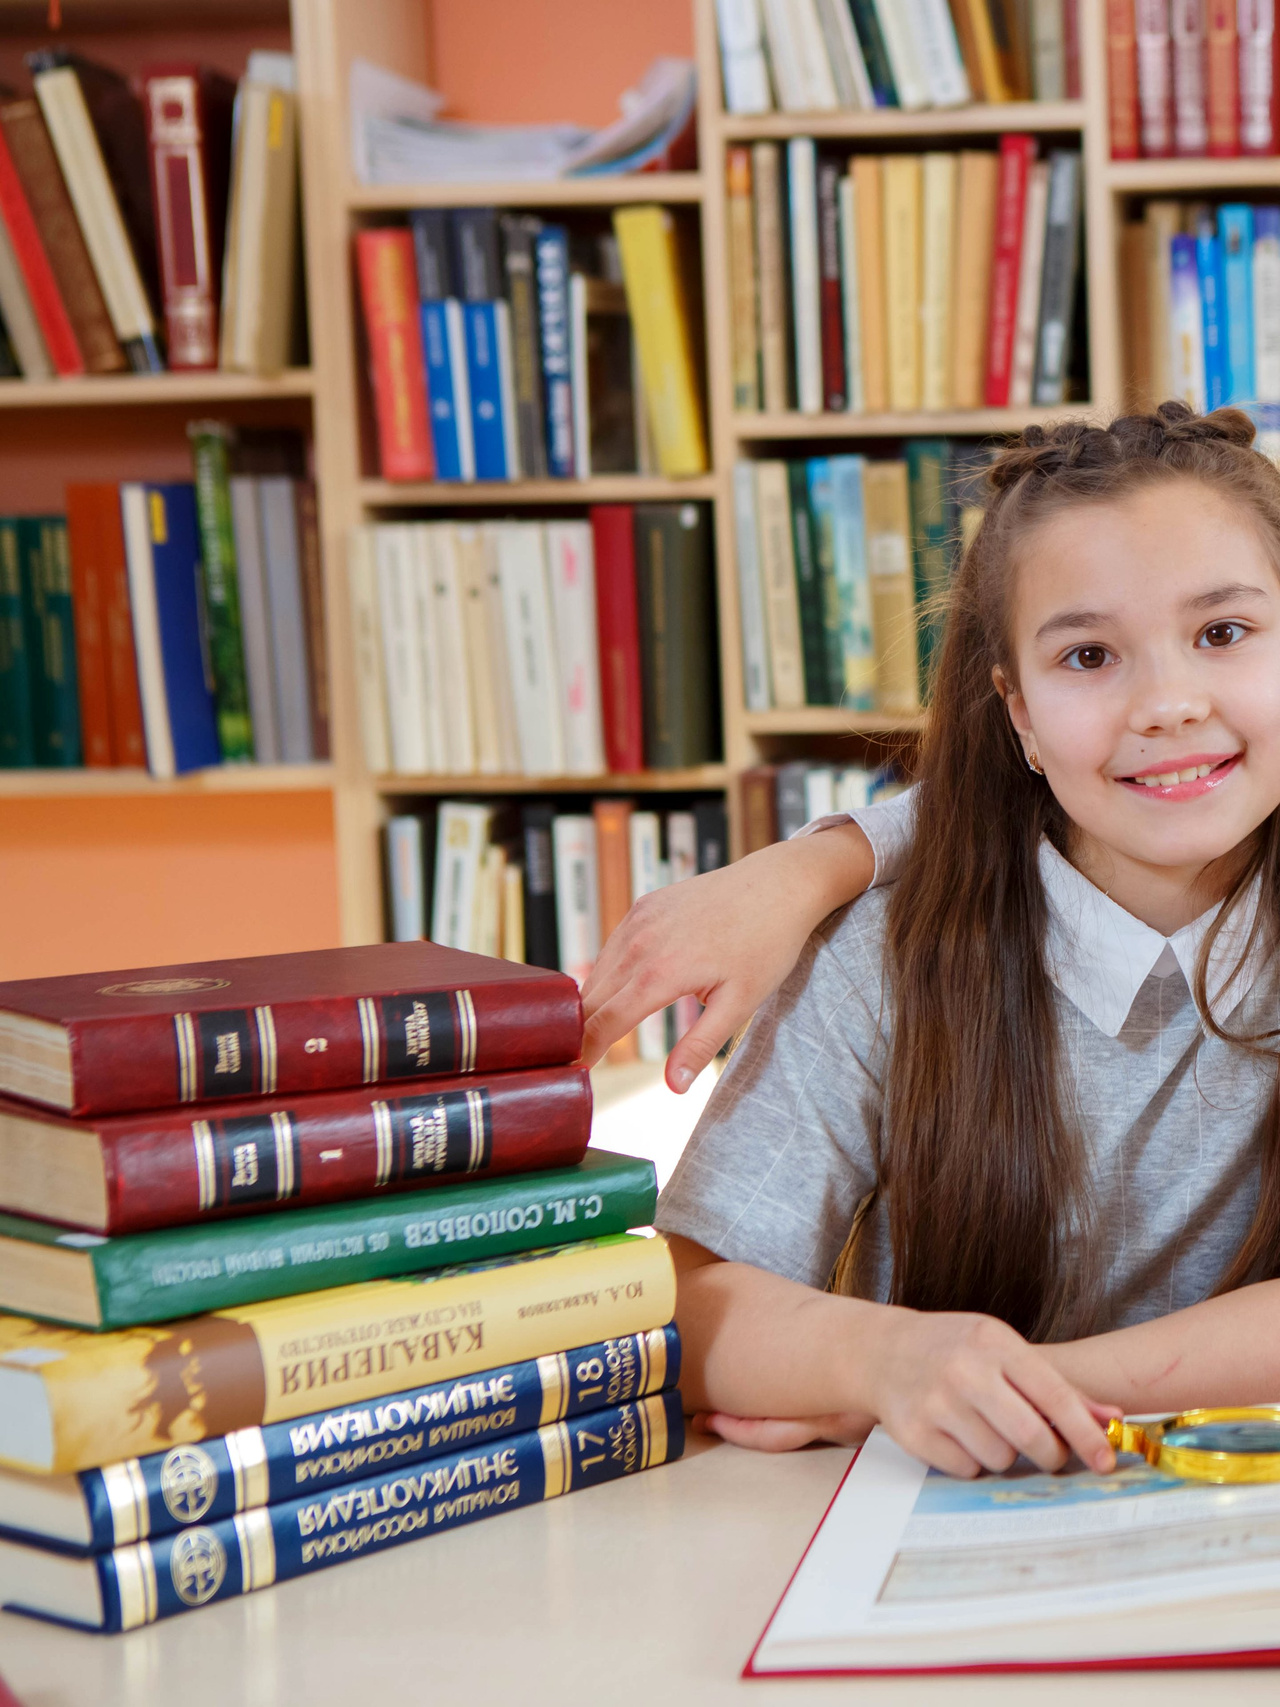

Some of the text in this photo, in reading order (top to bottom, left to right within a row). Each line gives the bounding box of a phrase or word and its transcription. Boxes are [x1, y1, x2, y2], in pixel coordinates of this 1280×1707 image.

[319, 1148, 344, 1164] 1
[289, 1234, 365, 1266] ИСТОРИИ
[276, 1320, 382, 1362] ОТЕЧЕСТВУ
[279, 1321, 485, 1397] КАВАЛЕРИЯ
[603, 1339, 622, 1405] ЛОМОН
[576, 1357, 604, 1403] 18
[288, 1374, 517, 1457] ЭНЦИКЛОПЕДИЯ
[295, 1406, 517, 1484] БОЛЬШАЯ РОССИЙСКАЯ
[618, 1404, 637, 1473] ЛОМОН
[576, 1429, 606, 1473] 17
[297, 1447, 519, 1537] ЭНЦИКЛОПЕДИЯ
[301, 1479, 520, 1564] БОЛЬШАЯ РОССИЙСКАЯ
